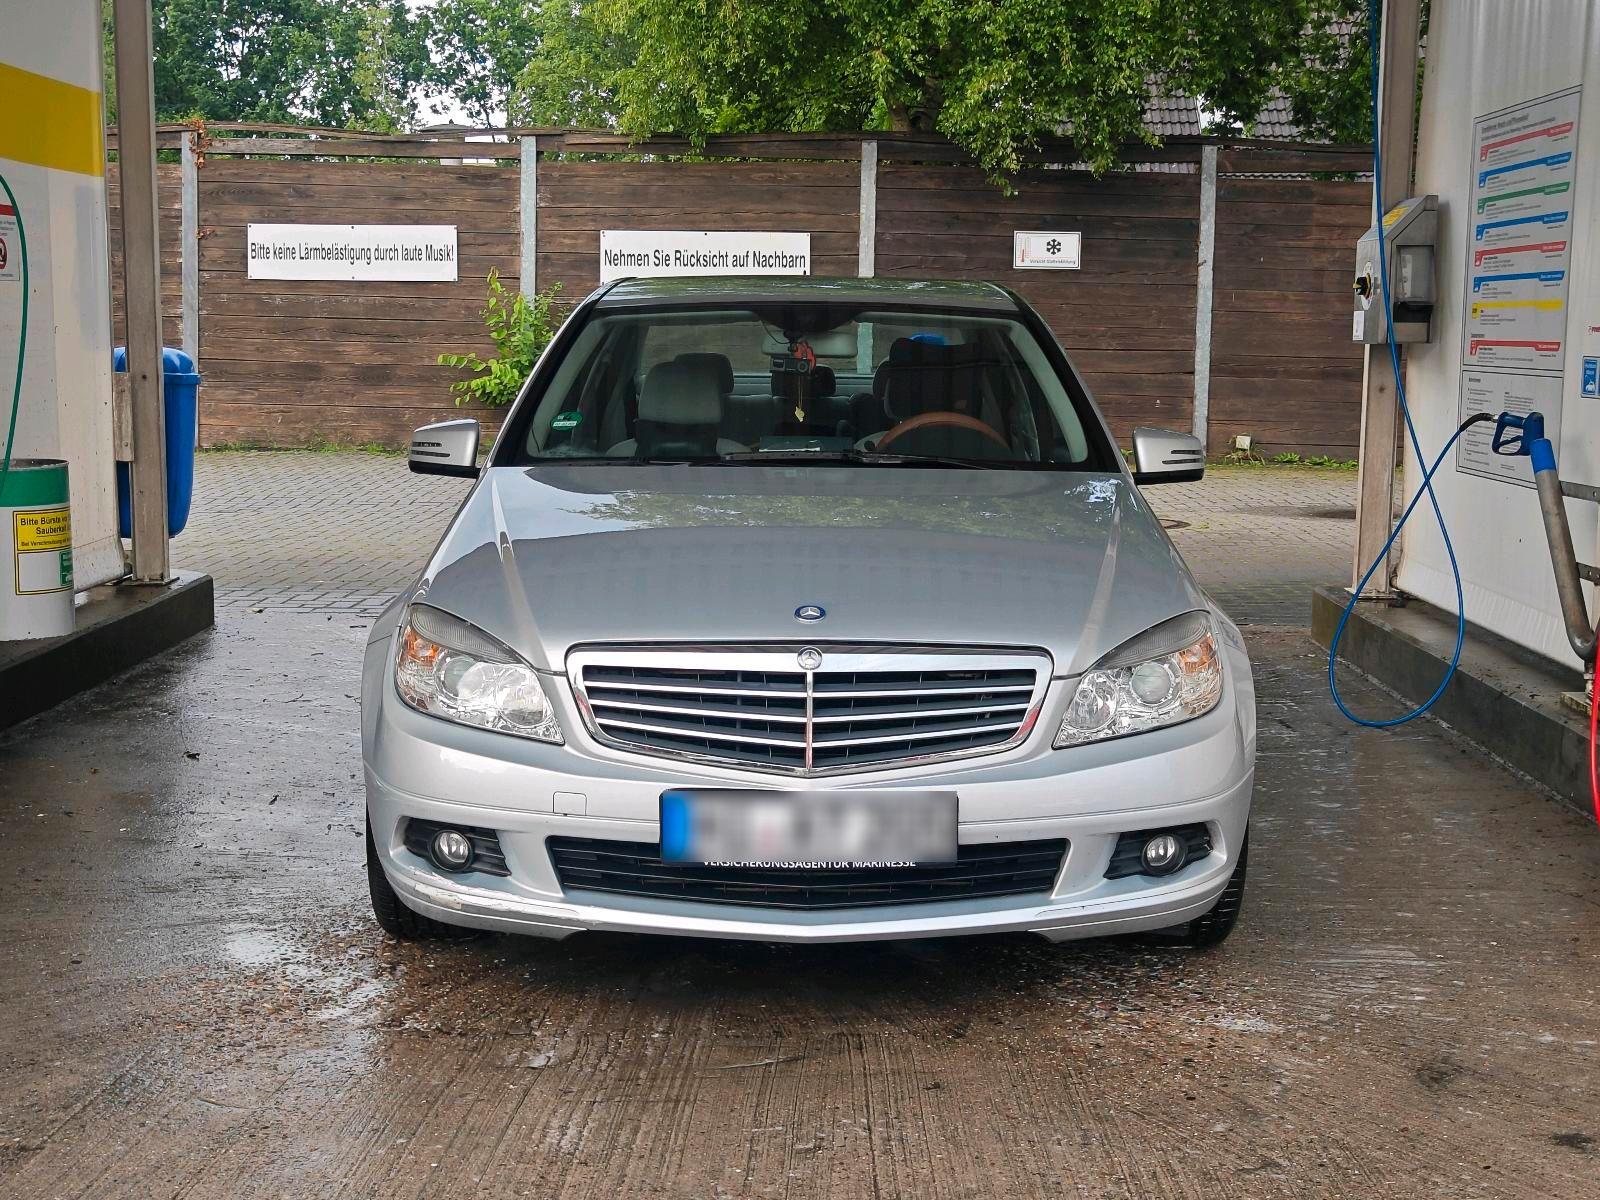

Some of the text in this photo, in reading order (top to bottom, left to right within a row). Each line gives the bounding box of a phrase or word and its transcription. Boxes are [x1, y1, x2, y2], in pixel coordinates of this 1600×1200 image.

[250, 242, 454, 265] Bitte keine Lärmbelästigung durch laute Musik!
[604, 249, 806, 268] Nehmen Sie Rücksicht auf Nachbarn
[20, 517, 39, 526] Bitte
